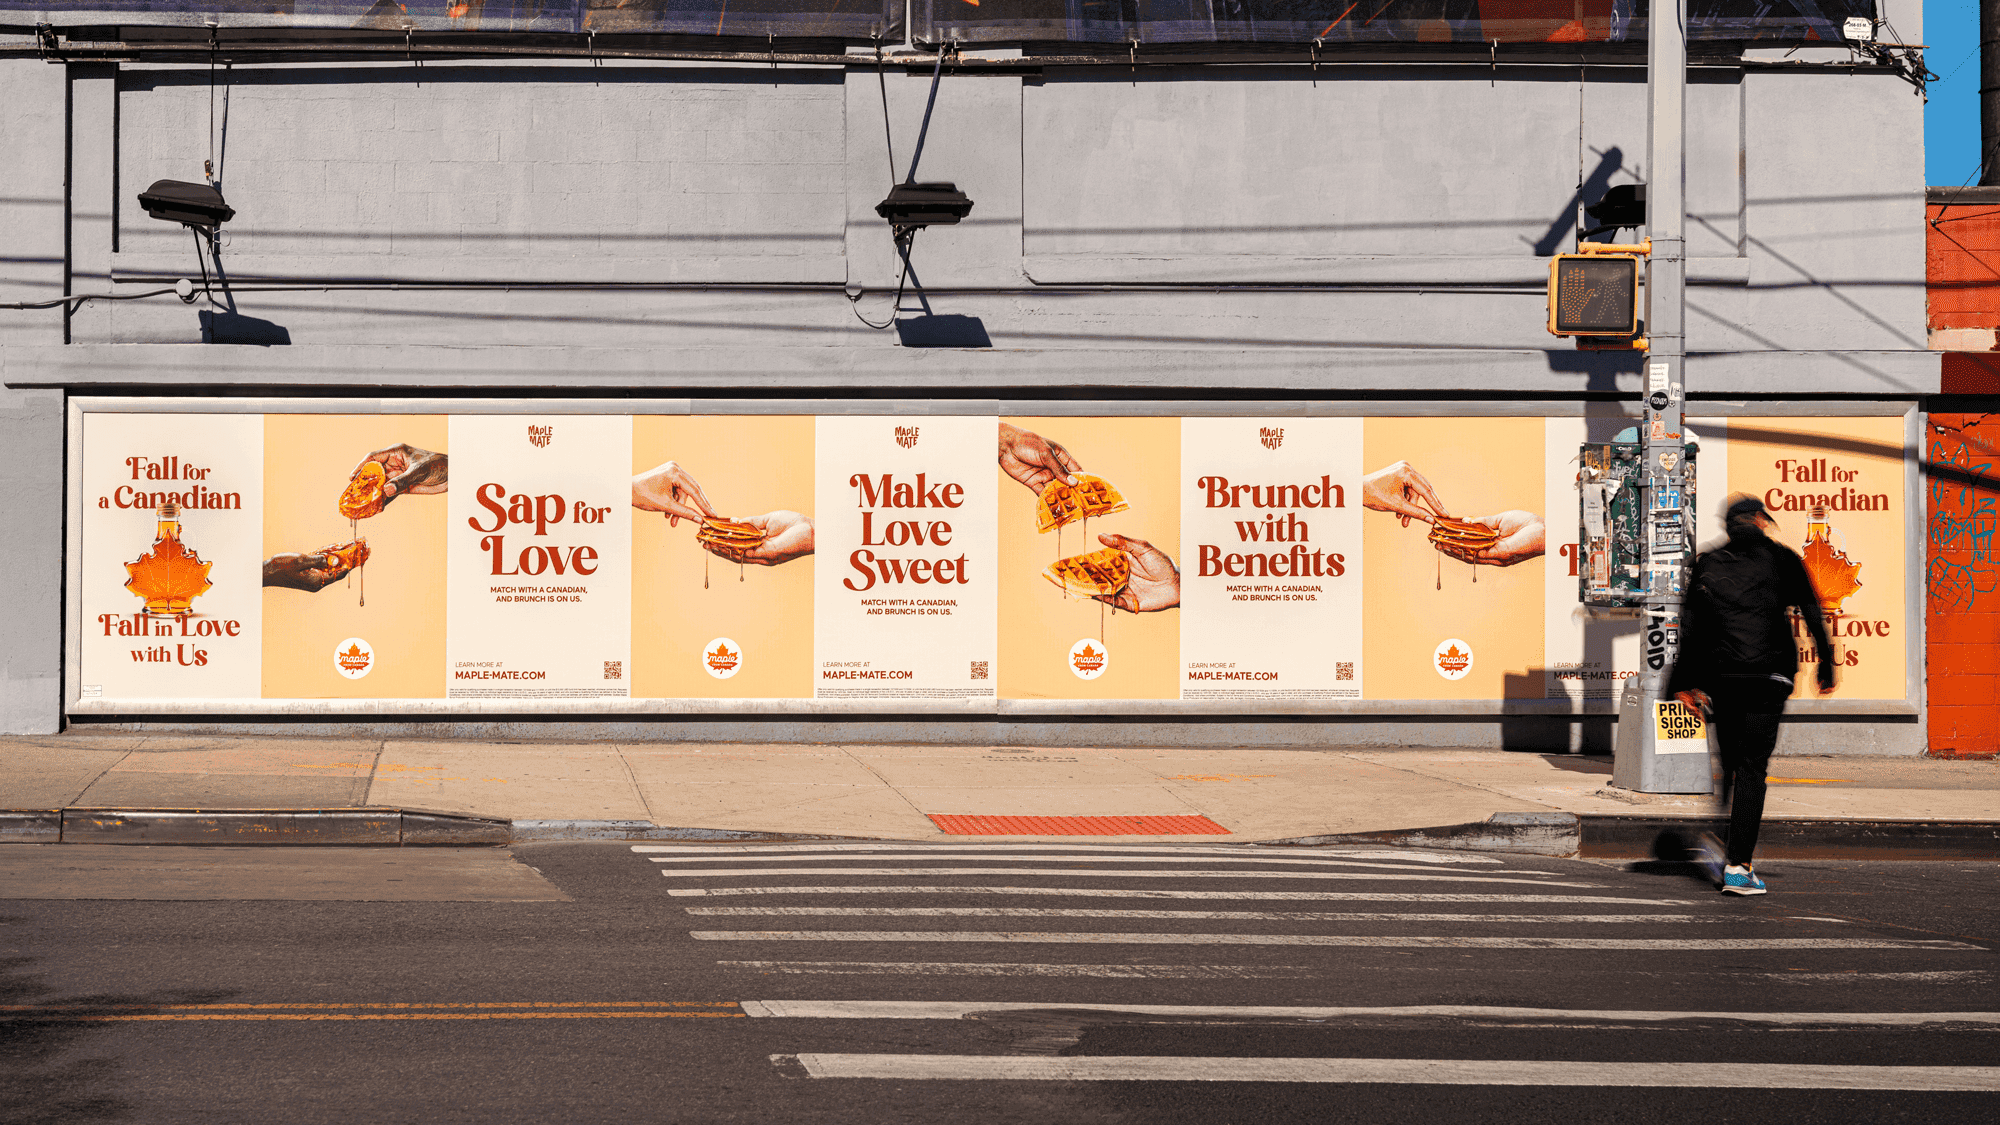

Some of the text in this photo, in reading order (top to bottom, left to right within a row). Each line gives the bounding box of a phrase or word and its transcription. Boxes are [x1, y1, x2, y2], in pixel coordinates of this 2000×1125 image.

[528, 424, 554, 436] MAPLE
[894, 425, 920, 437] MAPLE
[1260, 426, 1285, 438] MAPLE
[529, 436, 552, 448] MATE
[896, 437, 918, 449] MATE
[1261, 438, 1284, 450] MATE
[126, 456, 211, 480] Fall for
[1775, 458, 1859, 482] Fall for
[850, 472, 964, 508] Make
[1198, 475, 1345, 509] Brunch
[98, 485, 242, 510] a Canadian
[1764, 487, 1890, 511] Canadian
[468, 483, 612, 536] Sap for
[861, 512, 952, 546] Love
[1234, 512, 1309, 542] with
[480, 535, 599, 576] Love
[1198, 544, 1345, 577] Benefits
[843, 549, 969, 591] Sweet
[490, 586, 588, 595] MATCH WITH A CANADIAN,
[1227, 585, 1323, 594] MATCH WITH A CANADIAN,
[496, 595, 582, 603] AND BRUNCH IS ON US.
[861, 599, 958, 608] MATCH WITH A CANADIAN,
[1232, 594, 1317, 602] AND BRUNCH IS ON US.
[867, 608, 953, 616] AND BRUNCH IS ON US.
[98, 613, 240, 637] Fall in Love
[1826, 616, 1890, 637] Love
[131, 644, 208, 666] with Us
[340, 655, 367, 663] maple
[709, 655, 736, 663] maple
[1075, 656, 1101, 664] maple
[1440, 656, 1466, 664] maple
[1799, 644, 1859, 667] ith Us
[455, 670, 546, 680] MAPLE-MATE.COM
[822, 670, 913, 680] MAPLE-MATE.COM
[1188, 671, 1279, 681] MAPLE-MATE.COM
[1553, 671, 1639, 680] MAPLE-MATE.CO
[1659, 703, 1694, 716] PRIN
[1661, 716, 1702, 729] SIGNS
[1668, 729, 1697, 739] SHOP
